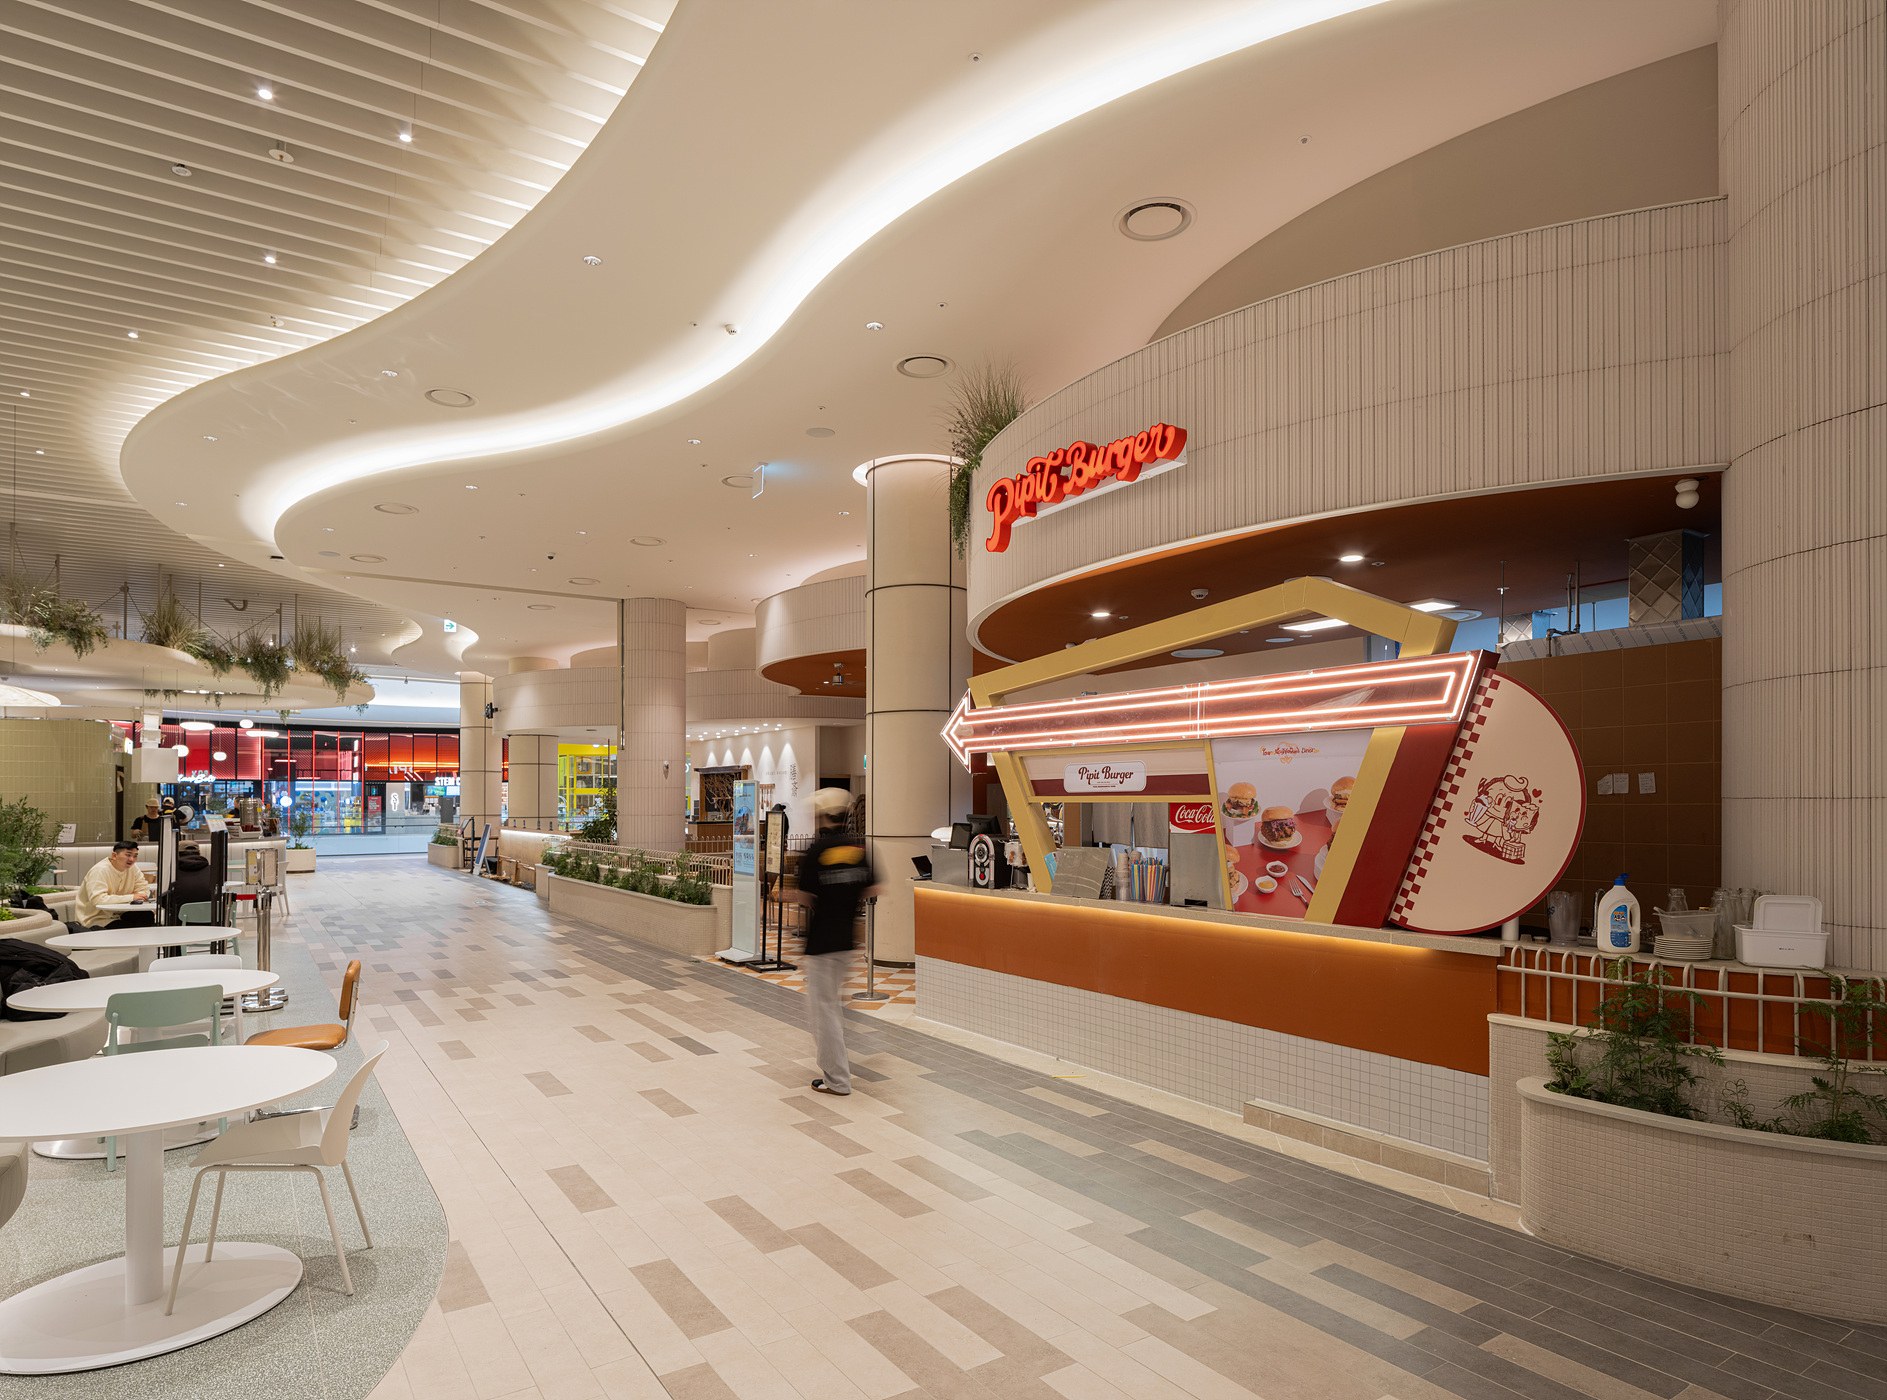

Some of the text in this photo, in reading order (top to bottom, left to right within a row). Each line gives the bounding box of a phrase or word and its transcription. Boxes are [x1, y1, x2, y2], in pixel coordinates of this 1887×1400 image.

[986, 422, 1187, 552] Pipit Burger
[1078, 765, 1134, 785] Pipit Burger
